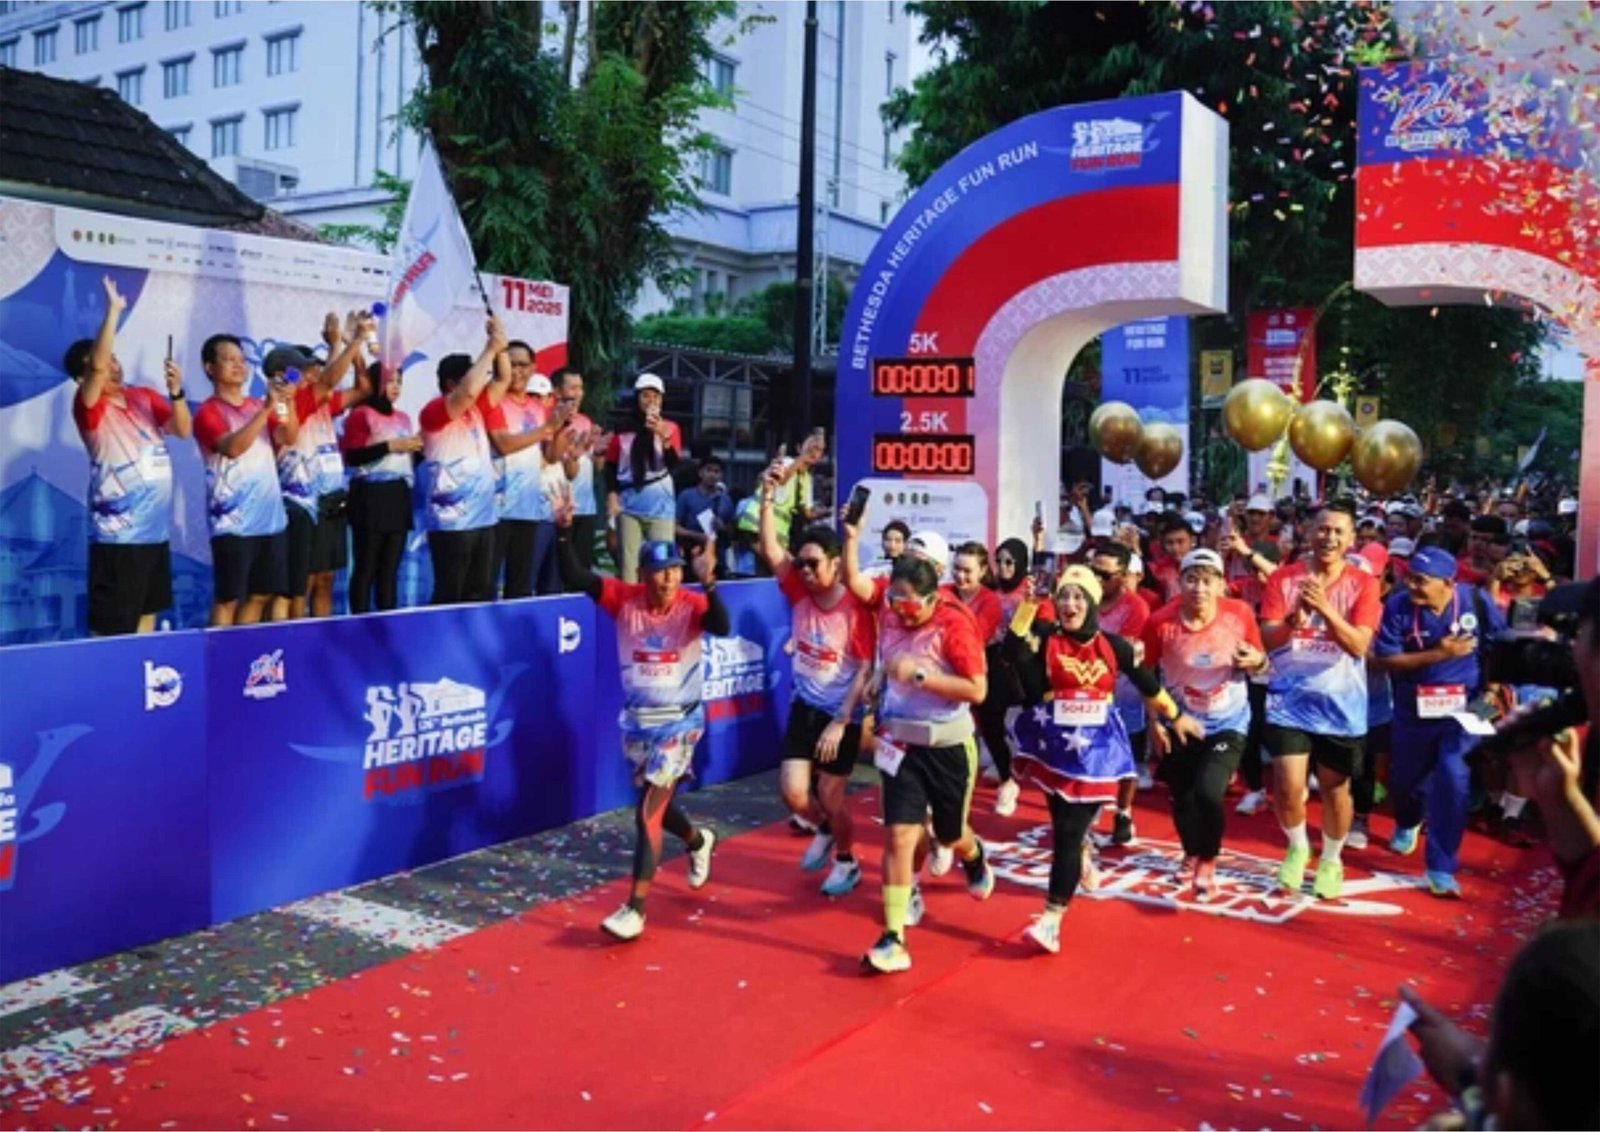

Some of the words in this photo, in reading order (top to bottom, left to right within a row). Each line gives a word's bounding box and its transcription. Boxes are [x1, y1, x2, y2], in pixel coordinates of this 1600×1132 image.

[852, 269, 894, 369] BETHESDA
[886, 187, 959, 269] HERITAGE
[958, 161, 996, 194] FUN
[998, 141, 1039, 171] RUN
[502, 278, 527, 311] 11
[908, 332, 939, 353] 5K
[900, 411, 949, 432] 2.5K
[876, 443, 971, 471] 00:00:00
[701, 673, 764, 700] ERITAGE
[363, 722, 487, 770] HERITAGE
[363, 762, 424, 799] FUN
